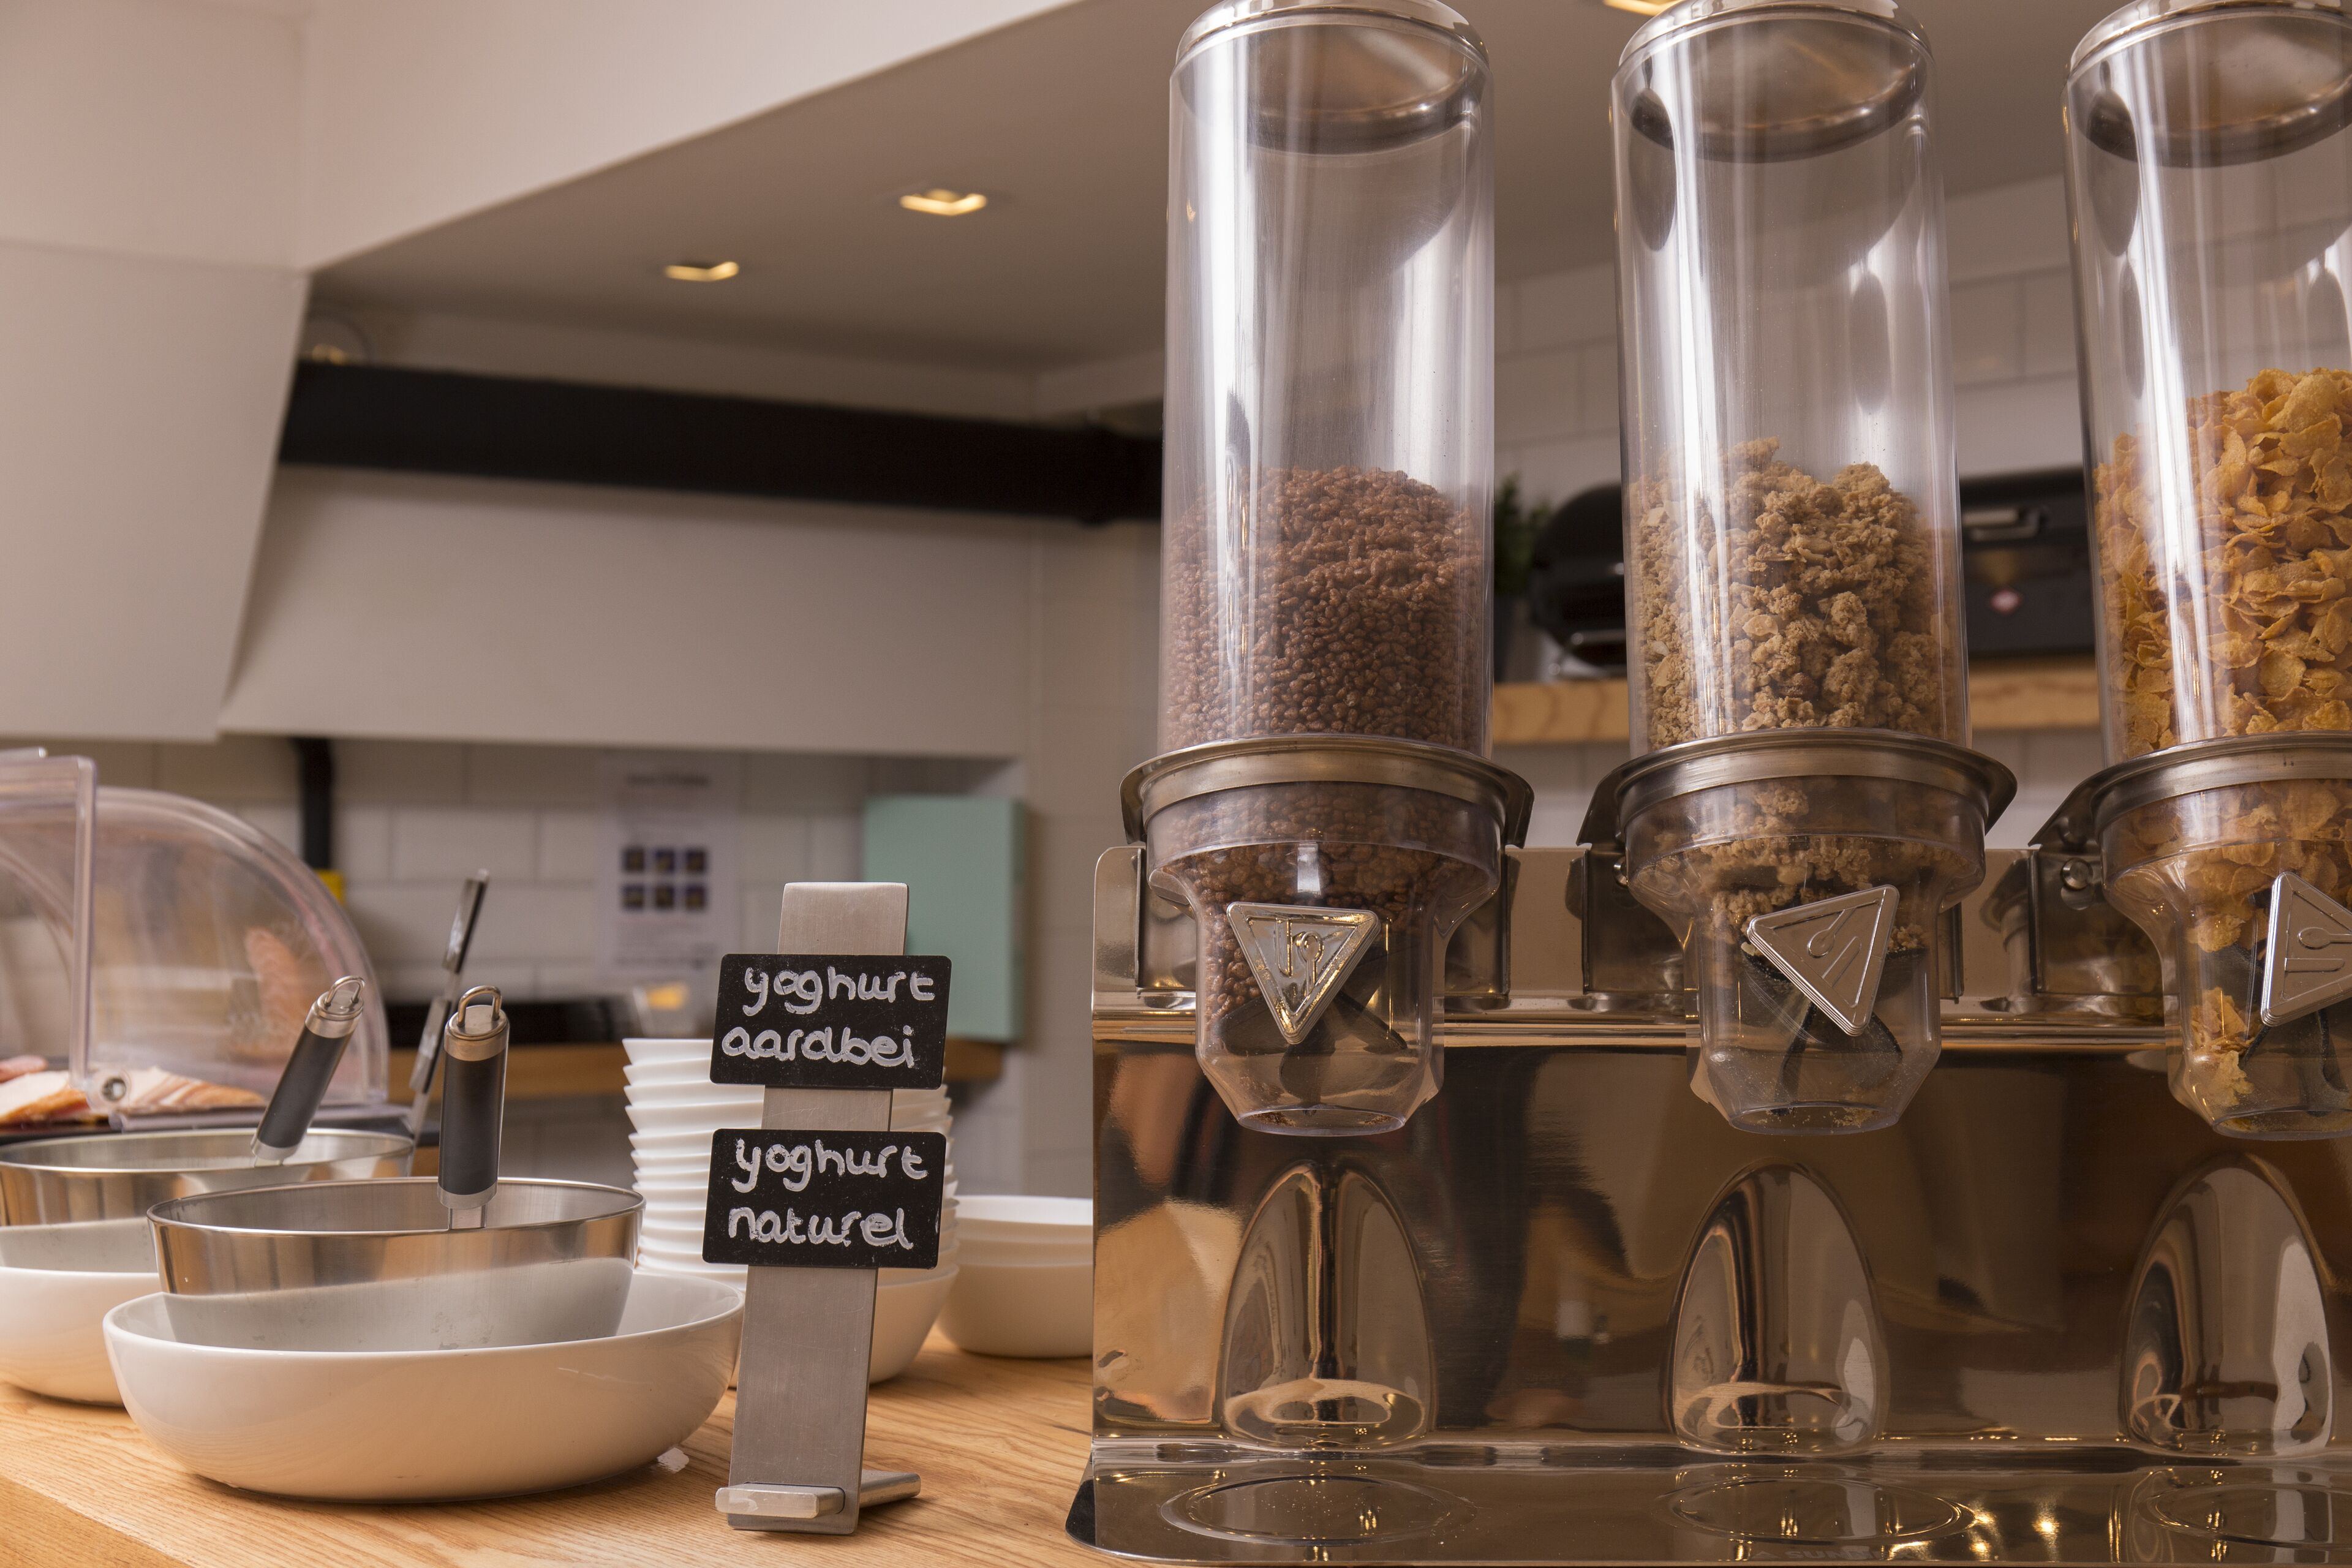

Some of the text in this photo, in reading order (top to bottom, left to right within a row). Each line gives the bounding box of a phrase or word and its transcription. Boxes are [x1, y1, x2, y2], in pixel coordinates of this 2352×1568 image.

[743, 967, 935, 1016] yoghurt
[722, 1025, 914, 1068] aardbei
[731, 1139, 929, 1193] yoghurt
[728, 1207, 914, 1250] naturel
